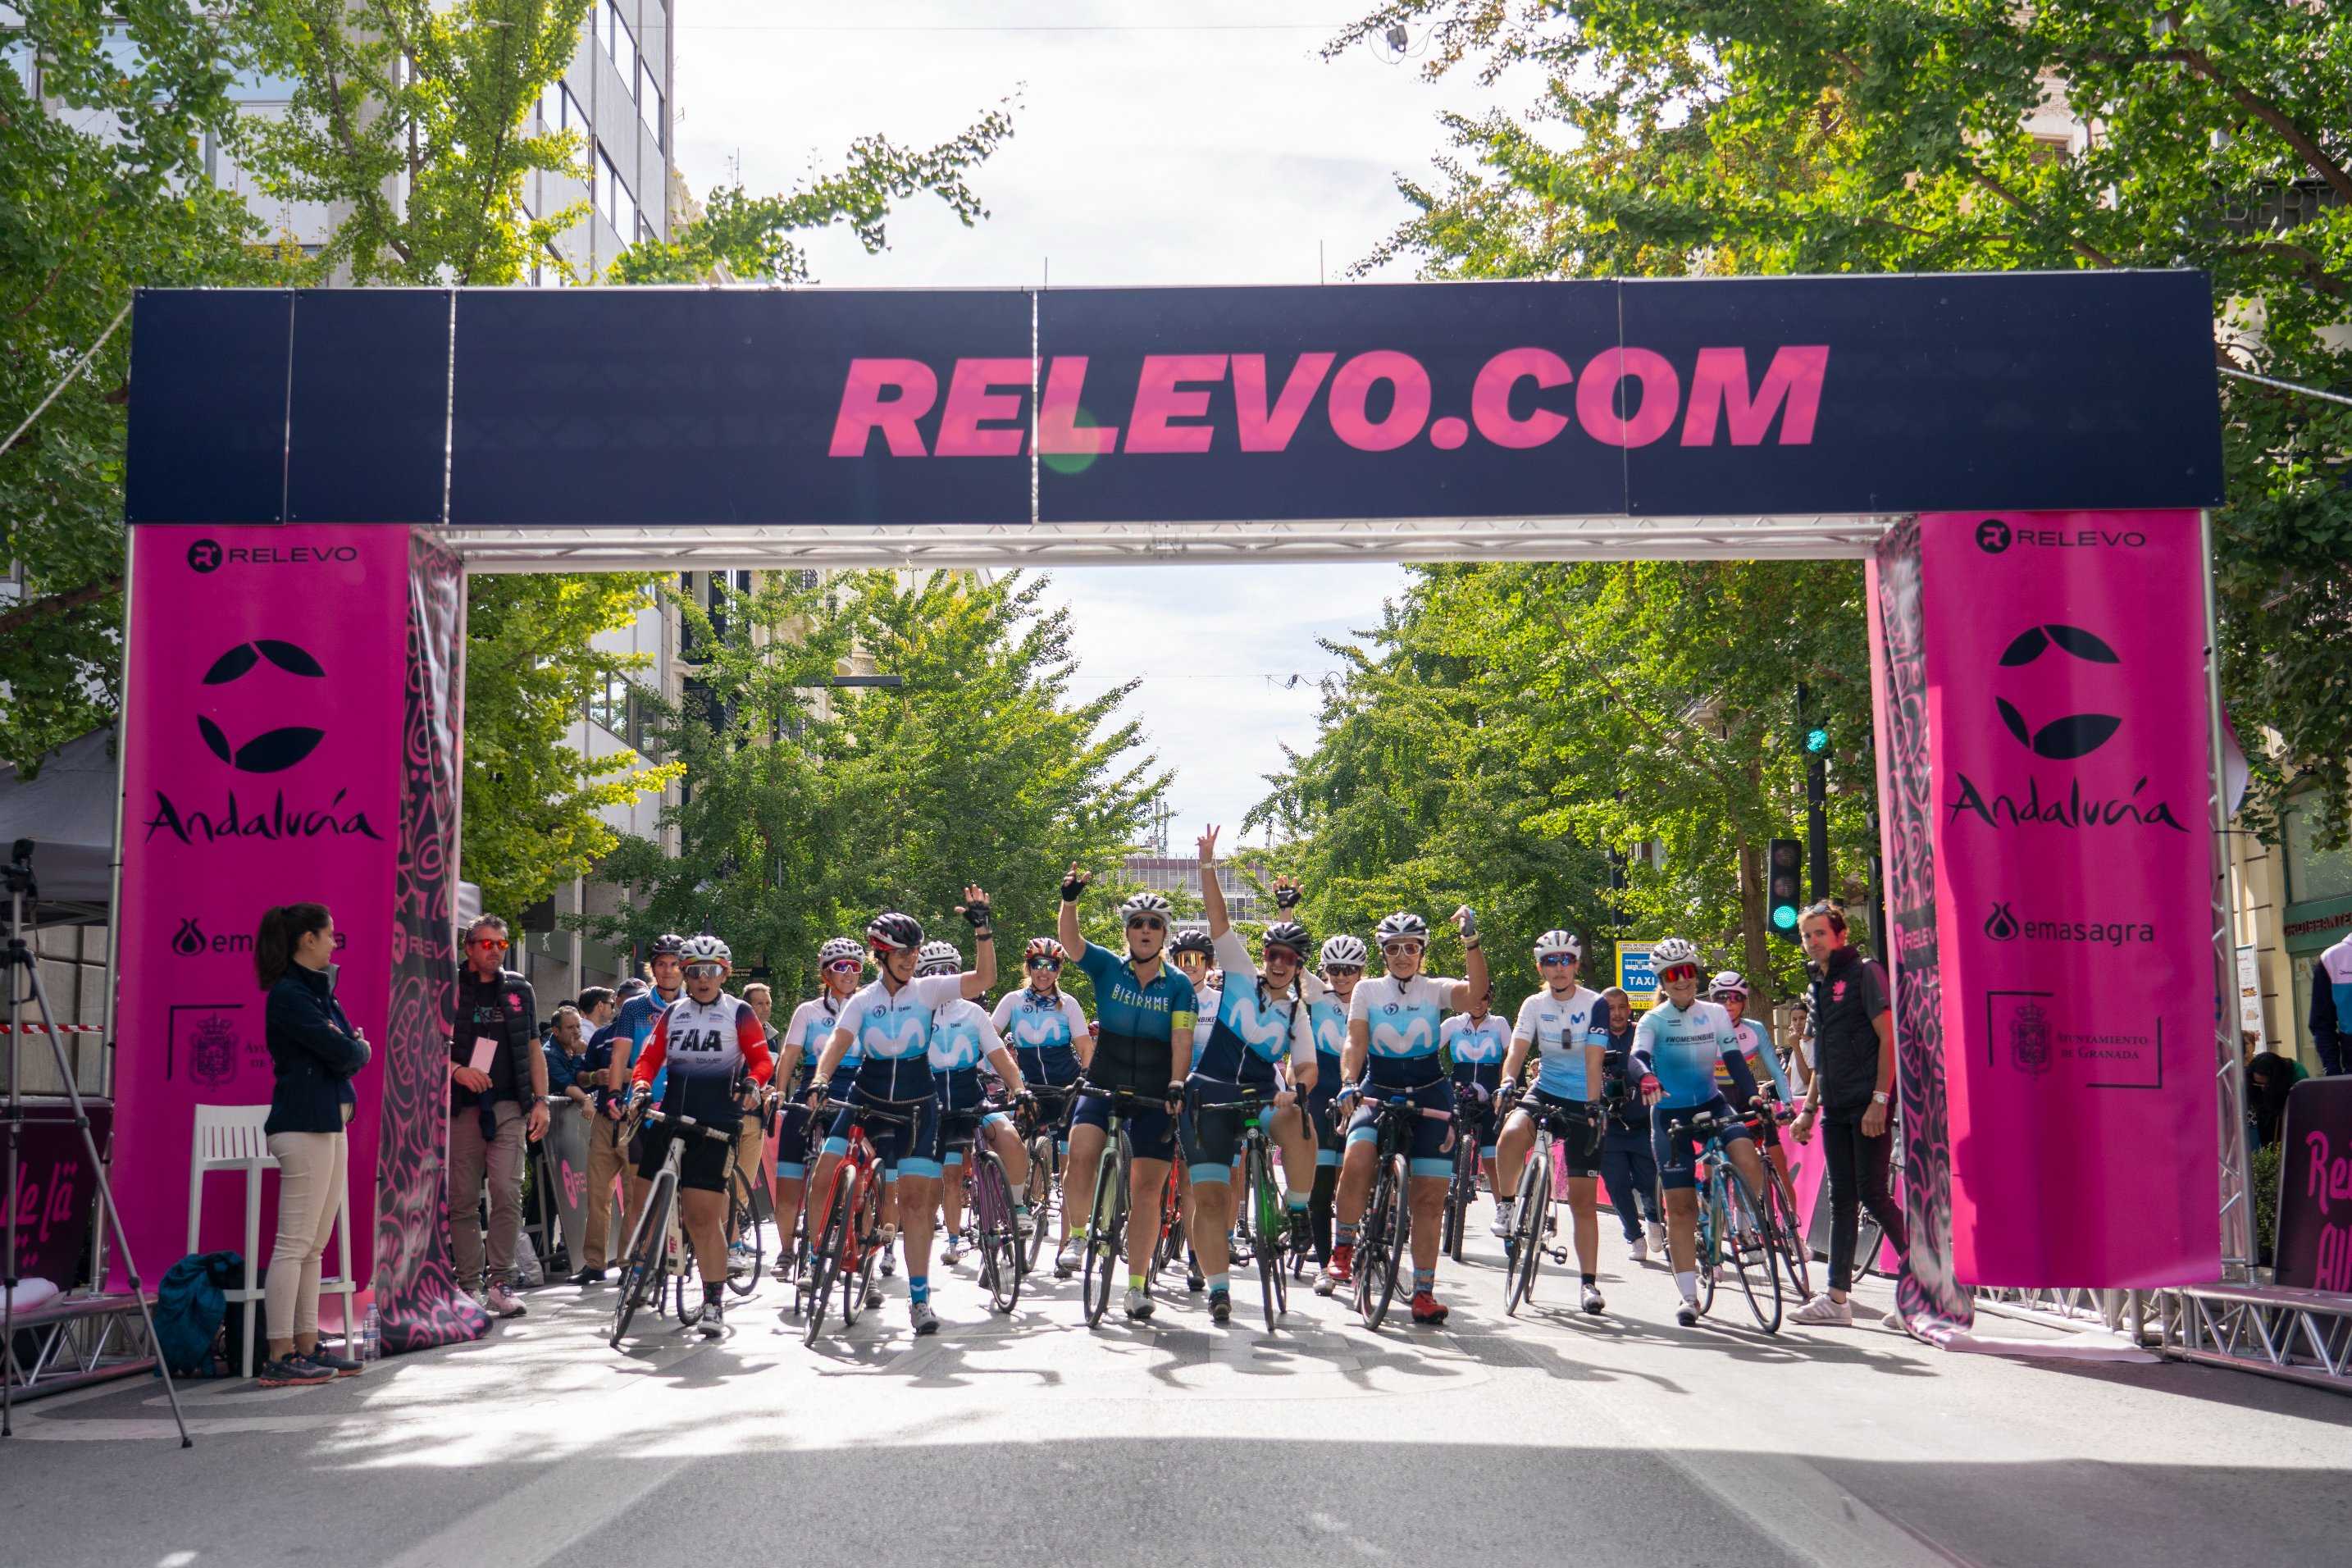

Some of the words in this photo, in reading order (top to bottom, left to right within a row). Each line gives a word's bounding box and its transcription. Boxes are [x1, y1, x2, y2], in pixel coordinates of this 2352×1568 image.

[828, 345, 1830, 458] RELEVO.COM
[2017, 530, 2146, 547] RELEVO
[228, 545, 358, 563] RELEVO
[1948, 772, 2192, 834] Andalucía
[142, 786, 385, 846] Andalucía
[2023, 919, 2155, 947] emasagra
[1628, 976, 1655, 986] TAXI
[668, 1028, 722, 1052] FAA
[1666, 1032, 1715, 1043] #WOMENINBIKE
